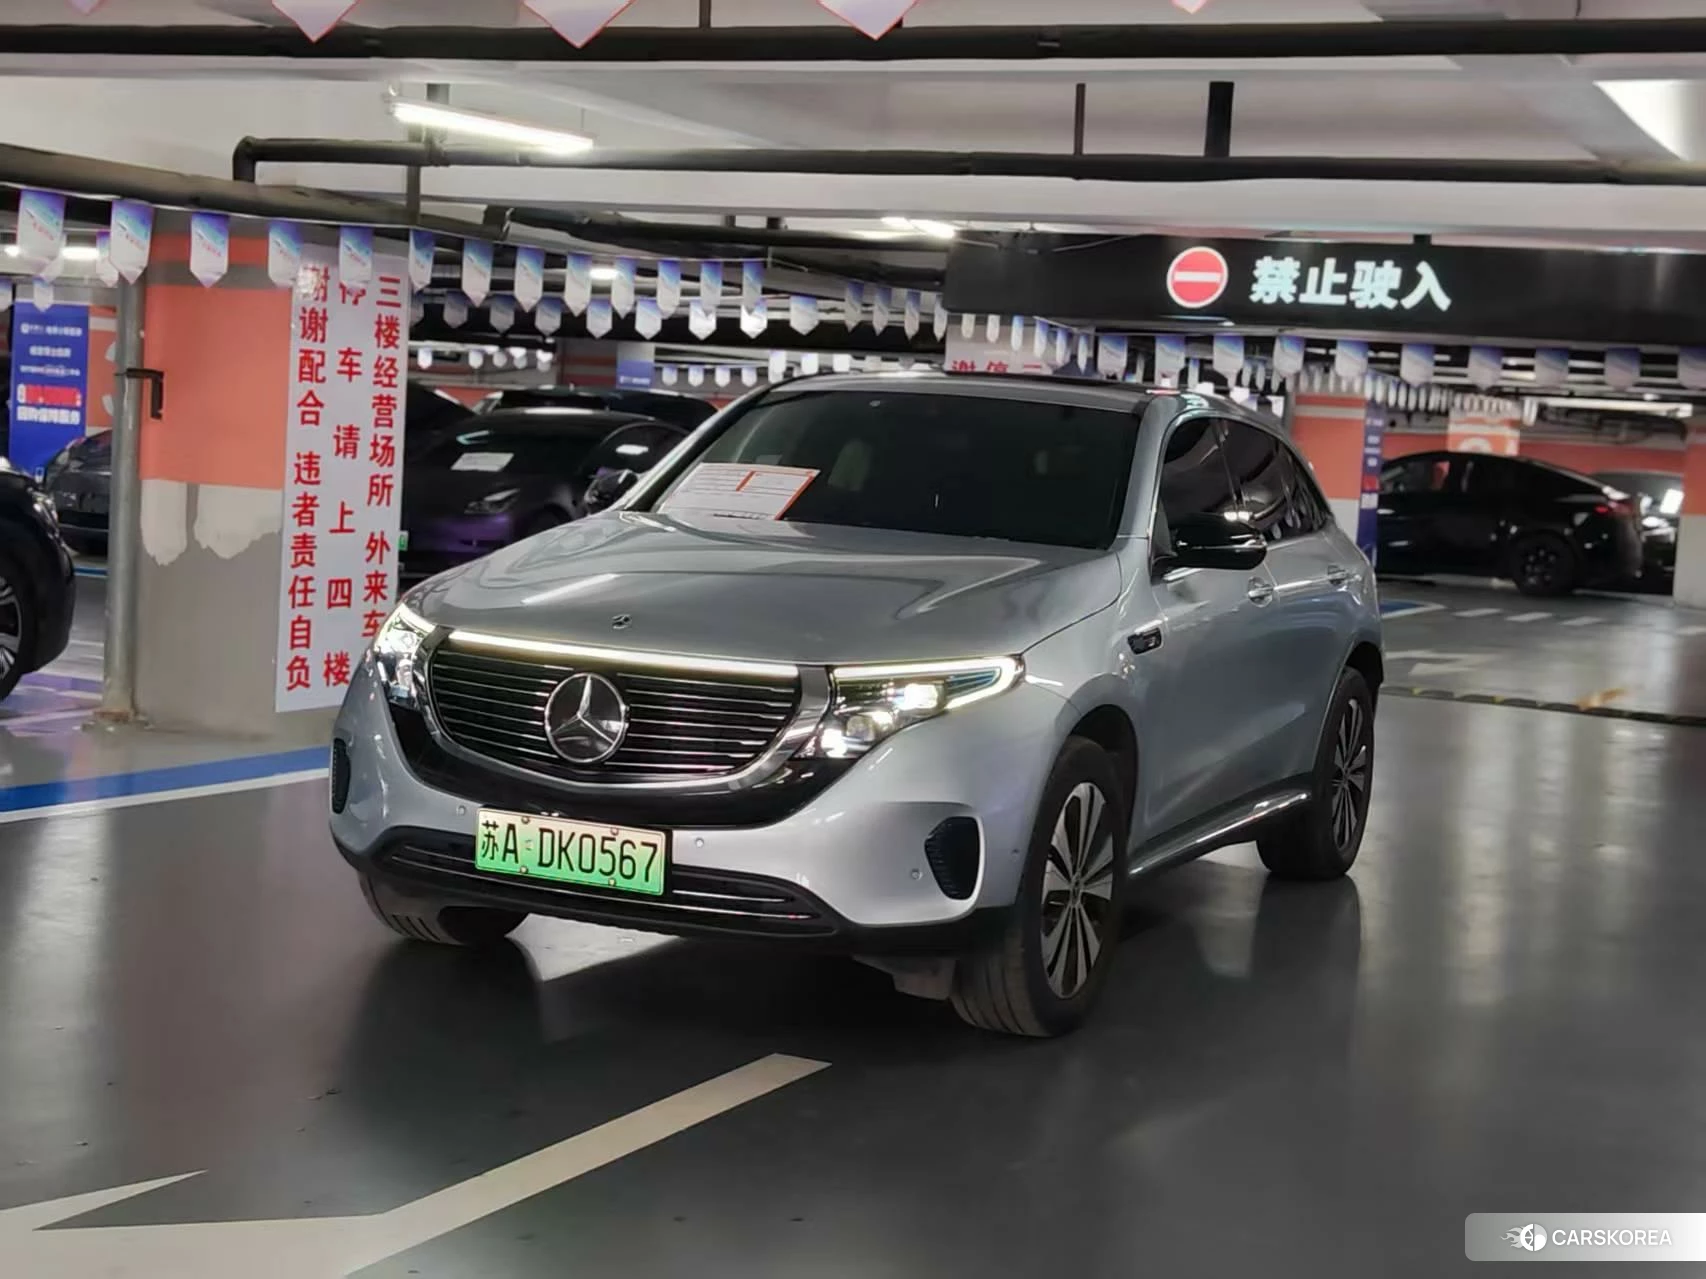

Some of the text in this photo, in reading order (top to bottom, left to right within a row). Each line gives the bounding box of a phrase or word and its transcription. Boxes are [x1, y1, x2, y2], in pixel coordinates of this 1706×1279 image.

[1249, 255, 1453, 312] 禁止驶入
[366, 275, 402, 508] 三楼经营场所
[286, 451, 322, 692] 违者责任自负
[481, 819, 659, 883] 苏A DK0567
